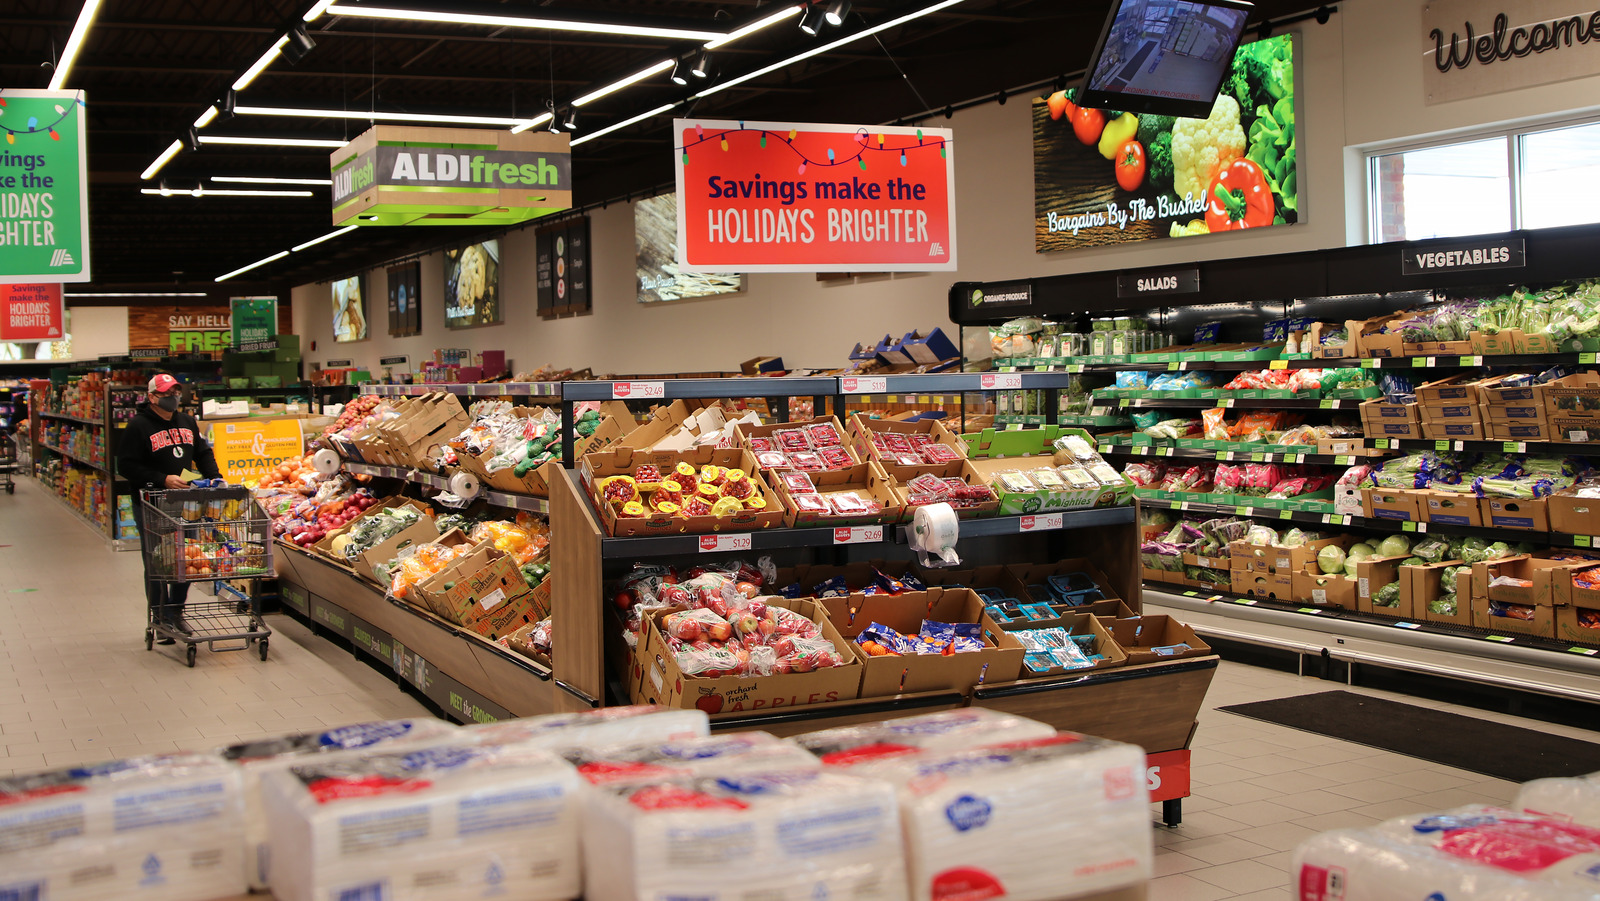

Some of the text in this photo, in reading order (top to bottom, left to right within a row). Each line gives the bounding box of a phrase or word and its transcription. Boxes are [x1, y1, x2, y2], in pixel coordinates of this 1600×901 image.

[1429, 10, 1600, 73] Welcome
[1160, 91, 1201, 100] PROGRESS
[391, 152, 559, 186] ALDIfresh
[22, 172, 54, 188] the
[334, 156, 374, 202] ALDIfresh
[708, 174, 927, 206] Savings make the
[0, 192, 54, 218] IDAYS
[1047, 189, 1210, 236] Bargains By The Bushel
[708, 208, 929, 244] HOLIDAYS BRIGHTER
[1416, 247, 1510, 269] VEGETABLES
[12, 285, 46, 293] Savings
[1137, 275, 1178, 292] SALADS
[35, 293, 50, 301] the
[984, 291, 1028, 302] ORGANIC PRODUCE
[10, 303, 51, 315] HOLIDAYS
[10, 315, 52, 328] BRIGHTER
[169, 315, 192, 327] SAY
[240, 328, 268, 338] HOLIDAYS
[240, 341, 276, 351] DRIED FRUIT
[1006, 378, 1021, 387] $3.29
[645, 386, 663, 396] $2.49
[228, 468, 256, 477] HAVE
[1045, 496, 1091, 508] Mighties
[1047, 517, 1062, 527] $1.69
[864, 531, 882, 540] $2.69
[732, 538, 751, 548] $1.29
[380, 641, 391, 659] DAILY
[725, 682, 758, 696] orchard
[450, 691, 463, 712] MEET
[463, 700, 472, 718] the
[728, 692, 750, 707] fresh
[730, 691, 840, 712] APPLES
